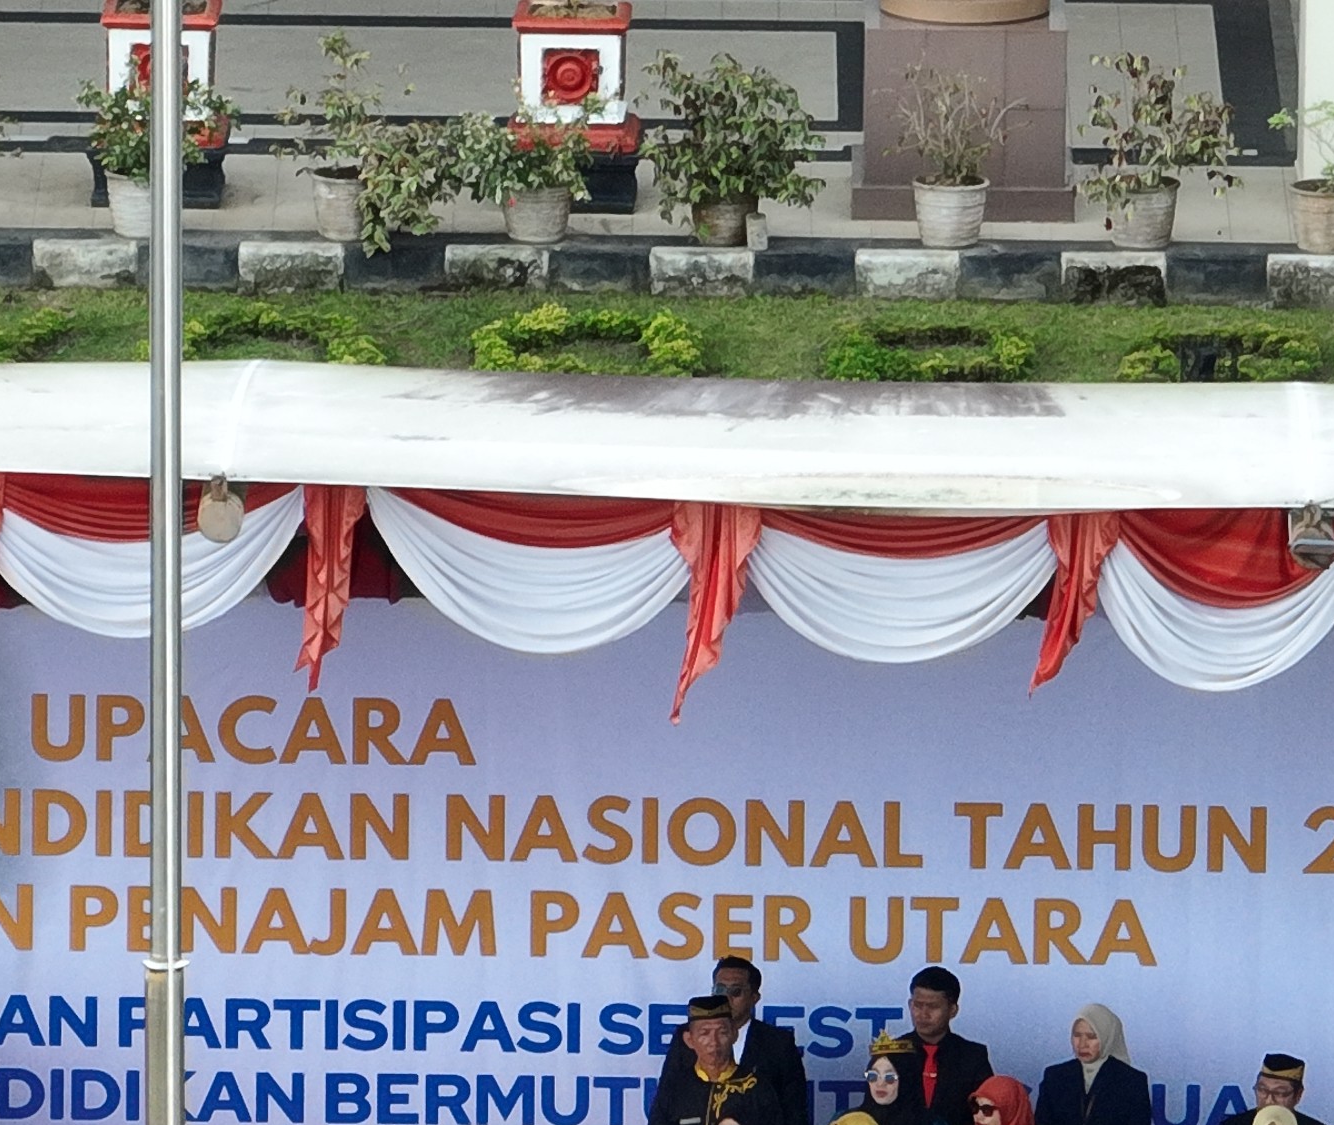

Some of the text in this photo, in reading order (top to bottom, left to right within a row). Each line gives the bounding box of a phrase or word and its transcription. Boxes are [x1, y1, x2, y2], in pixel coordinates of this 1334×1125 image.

[445, 793, 924, 869] NASIONAL
[954, 800, 1269, 873] TAHUN
[69, 884, 498, 956] PENAJAM
[530, 890, 816, 962] PASER
[849, 896, 1157, 967] UTARA
